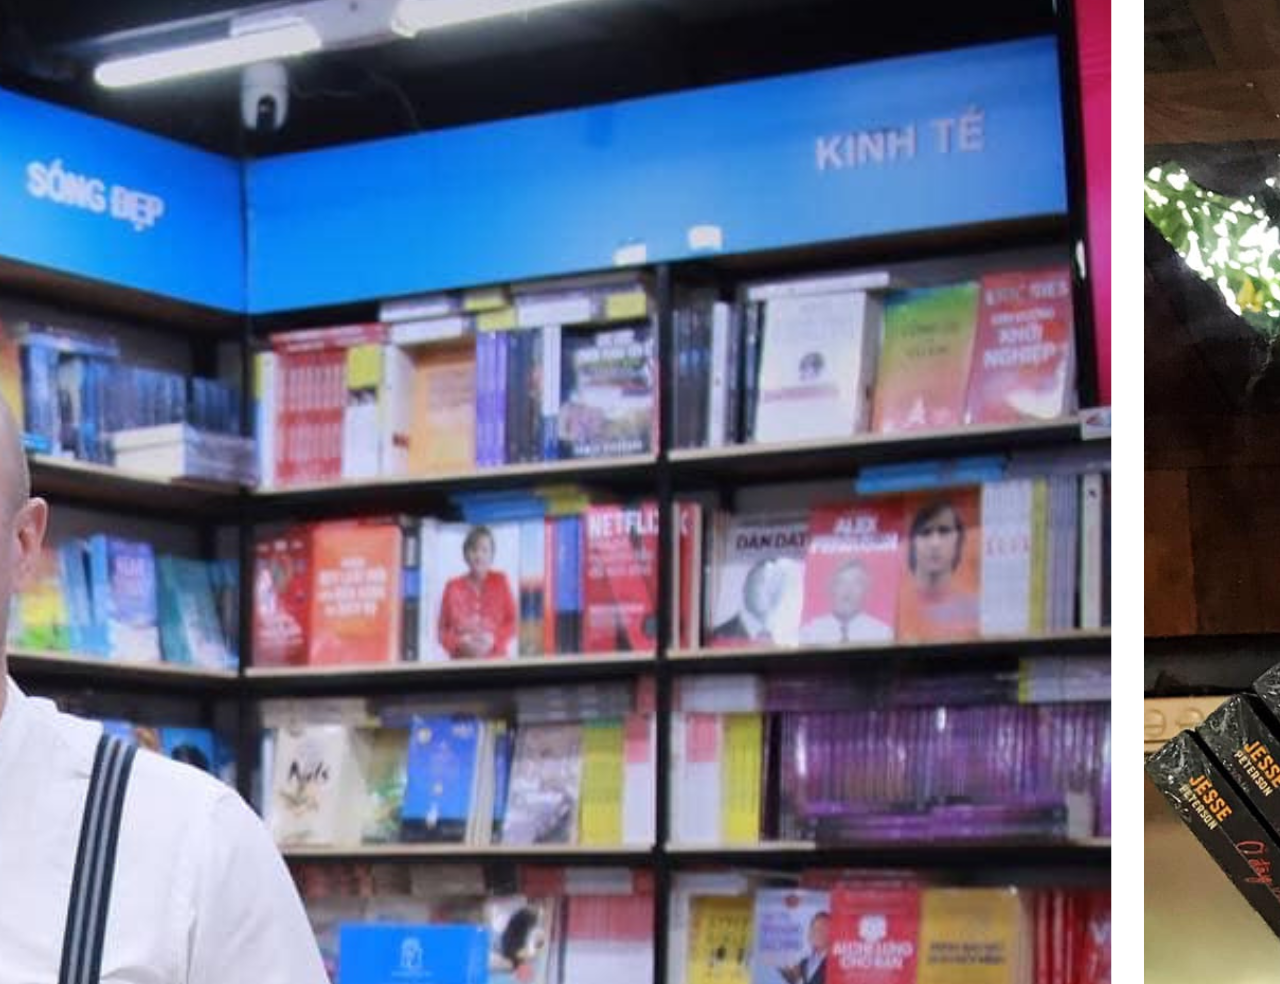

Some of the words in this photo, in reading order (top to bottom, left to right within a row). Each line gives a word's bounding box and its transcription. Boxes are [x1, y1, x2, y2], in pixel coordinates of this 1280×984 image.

[815, 124, 917, 171] KINH
[589, 508, 660, 540] NETFLI
[1232, 748, 1274, 797] PETERSON
[1177, 782, 1219, 831] PETERSON
[1188, 774, 1234, 823] JESSE
